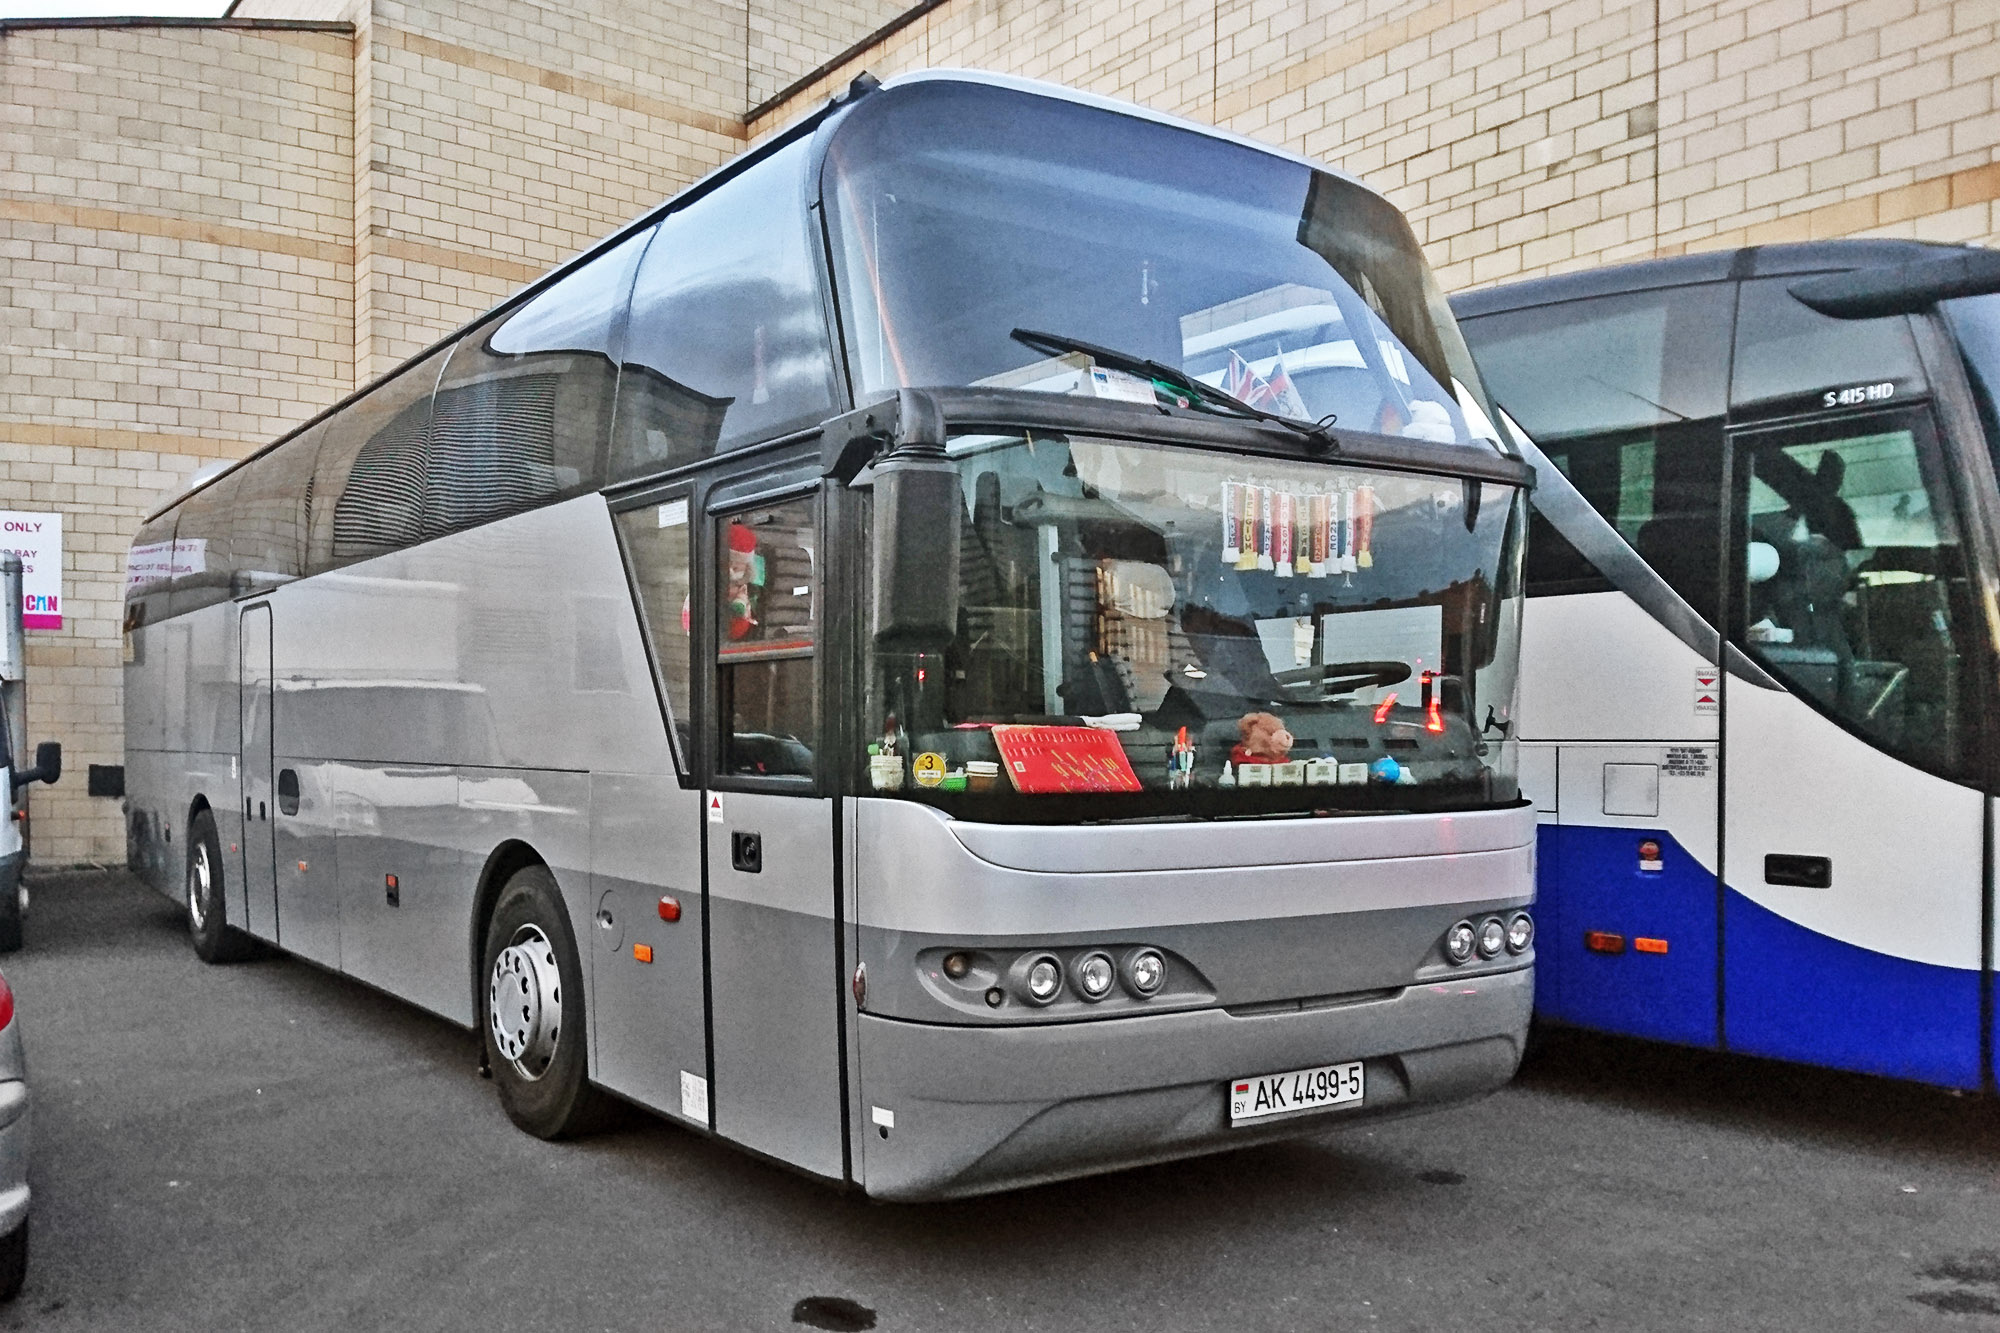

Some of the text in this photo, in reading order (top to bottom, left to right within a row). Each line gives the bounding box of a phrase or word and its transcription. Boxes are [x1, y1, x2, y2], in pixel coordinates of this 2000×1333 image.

[1823, 383, 1894, 408] S 415 HD
[4, 521, 42, 532] ONLY
[1244, 493, 1253, 550] BELGIUM
[1263, 496, 1272, 551] HOLLAND
[1280, 502, 1289, 554] POLSKA
[1330, 503, 1338, 550] FRANCE
[924, 755, 934, 770] 3
[1234, 1100, 1247, 1114] BY
[1254, 1066, 1360, 1111] AK 4499-5
